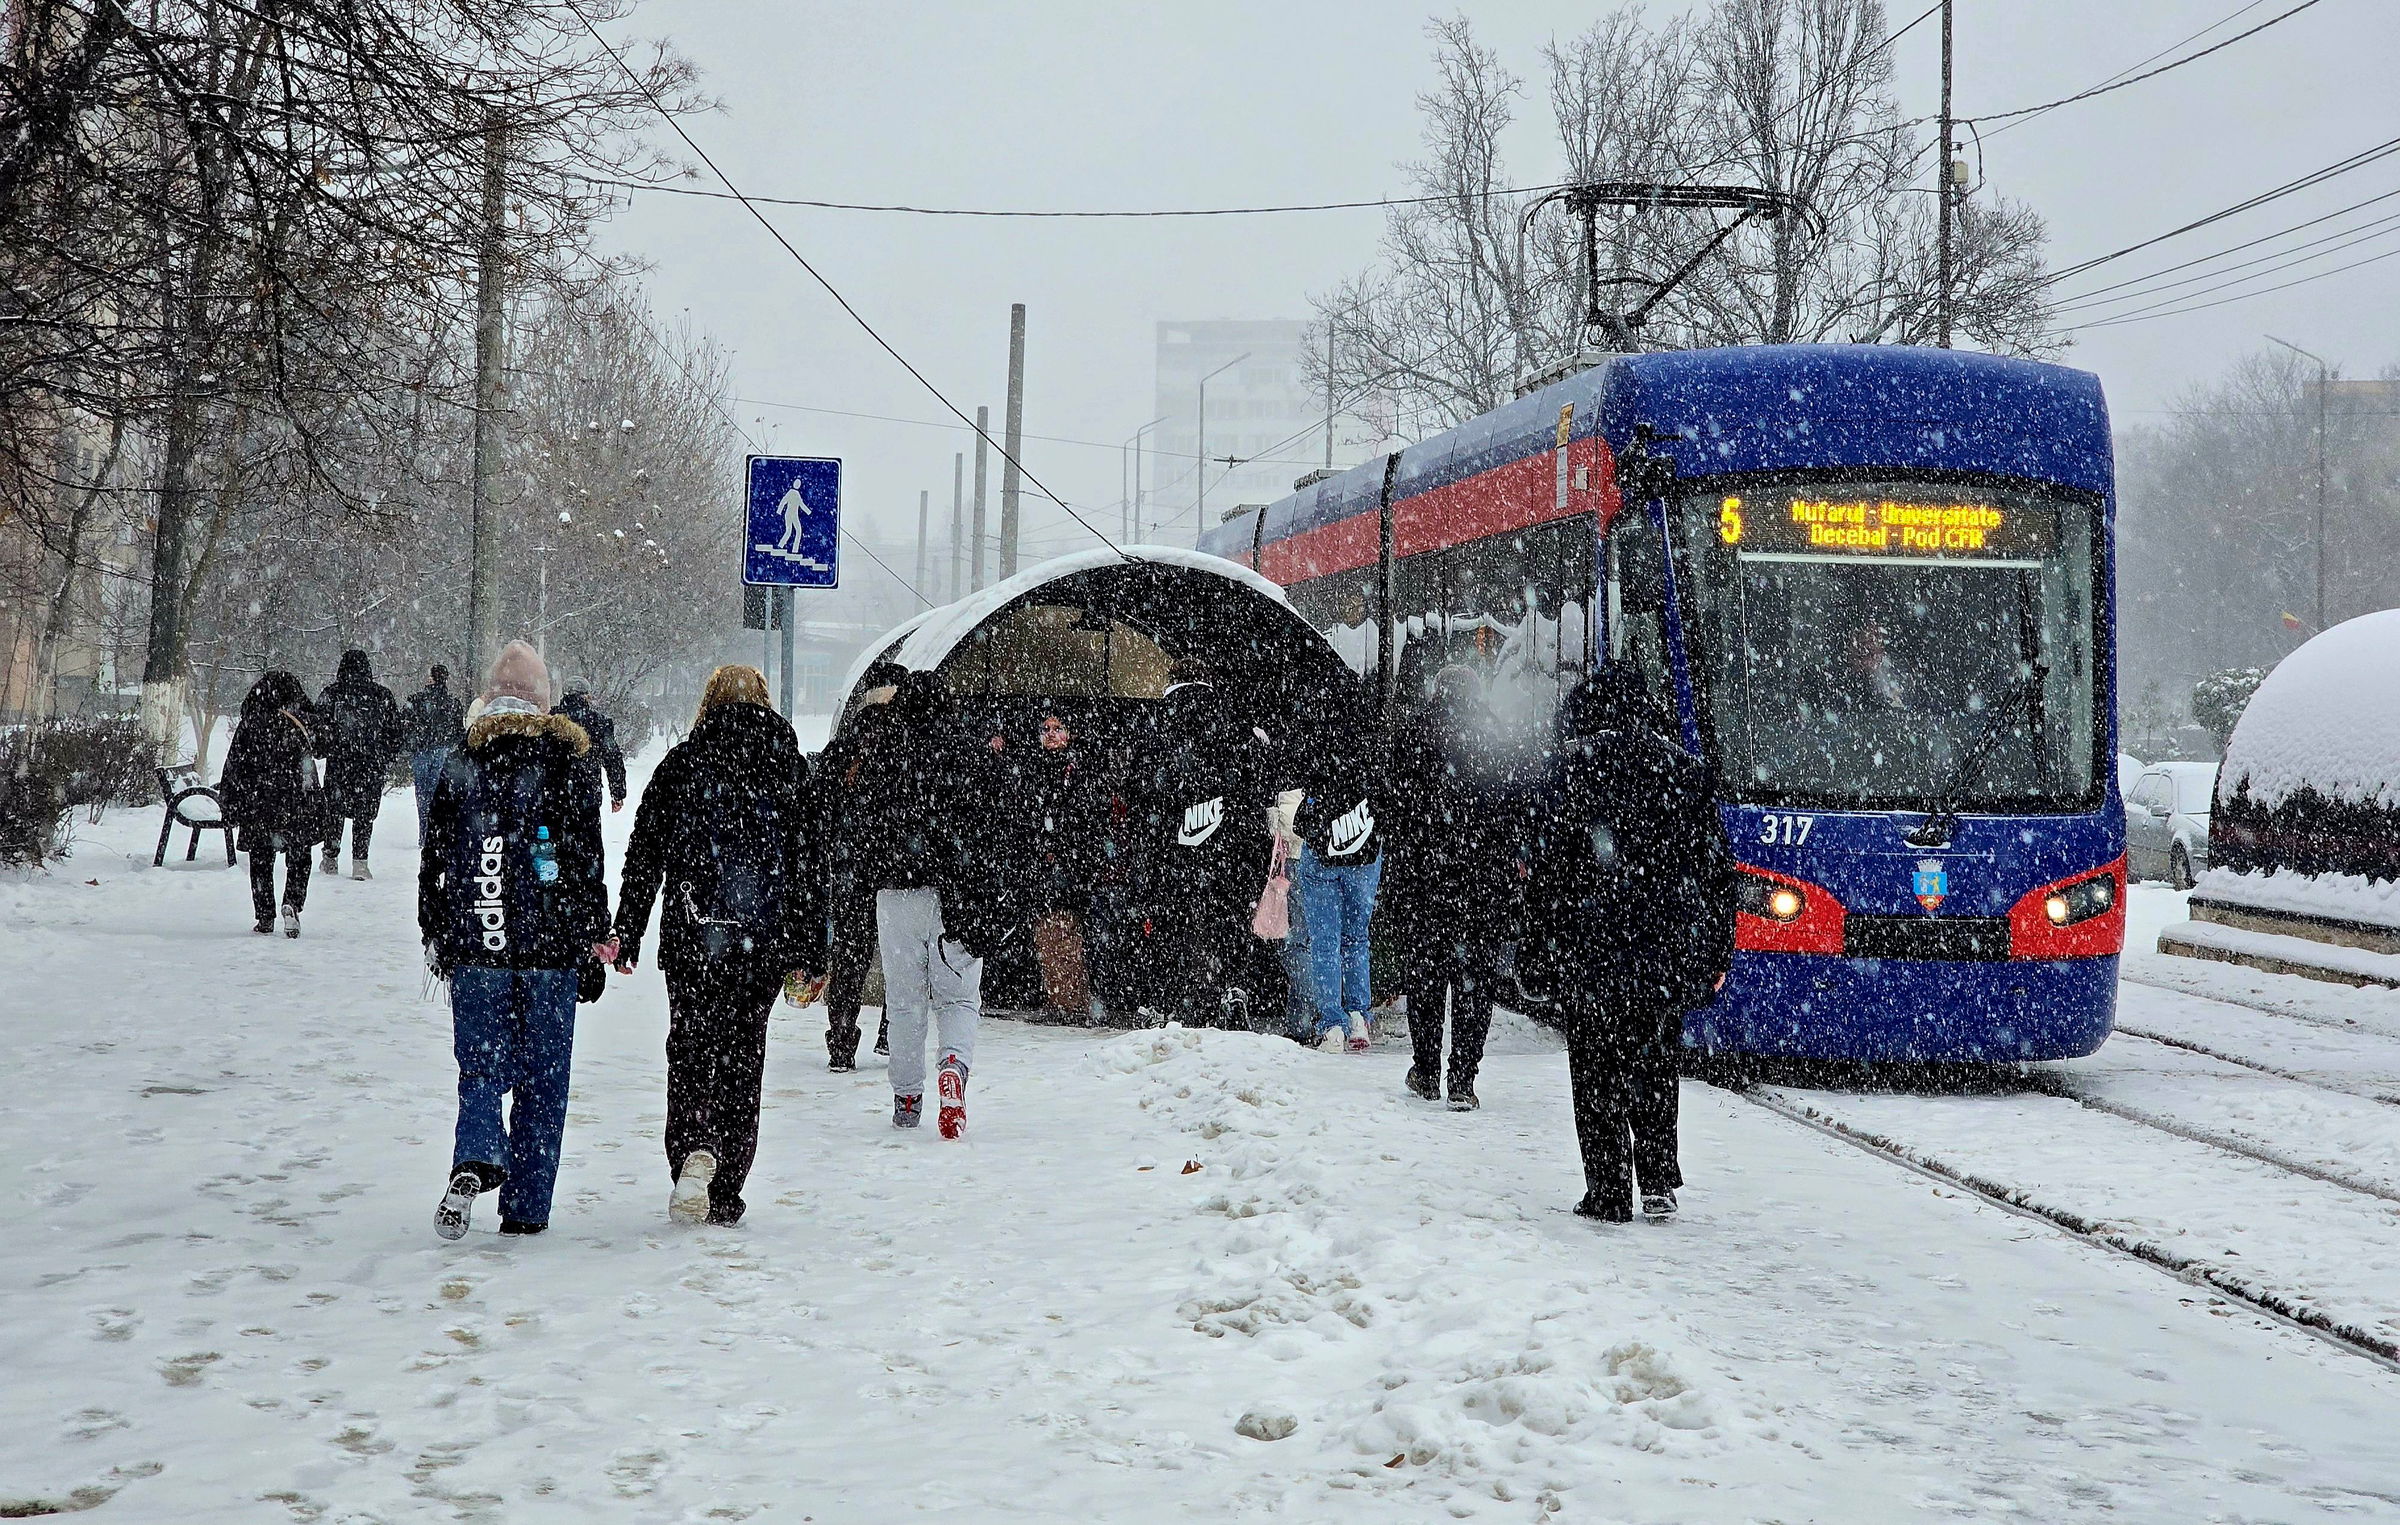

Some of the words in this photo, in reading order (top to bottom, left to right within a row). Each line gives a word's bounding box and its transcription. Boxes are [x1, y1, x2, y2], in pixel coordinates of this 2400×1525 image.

[1719, 496, 1743, 545] 5
[1792, 500, 1867, 523] Nufarul
[1880, 502, 2002, 527] Universitate
[1810, 523, 1888, 547] Decebal
[1903, 525, 1940, 548] Pod
[1944, 527, 1985, 549] CFR
[1184, 796, 1224, 833] NIKE
[1331, 798, 1371, 847] NIKE
[1760, 814, 1814, 846] 317
[473, 835, 508, 952] adidas
